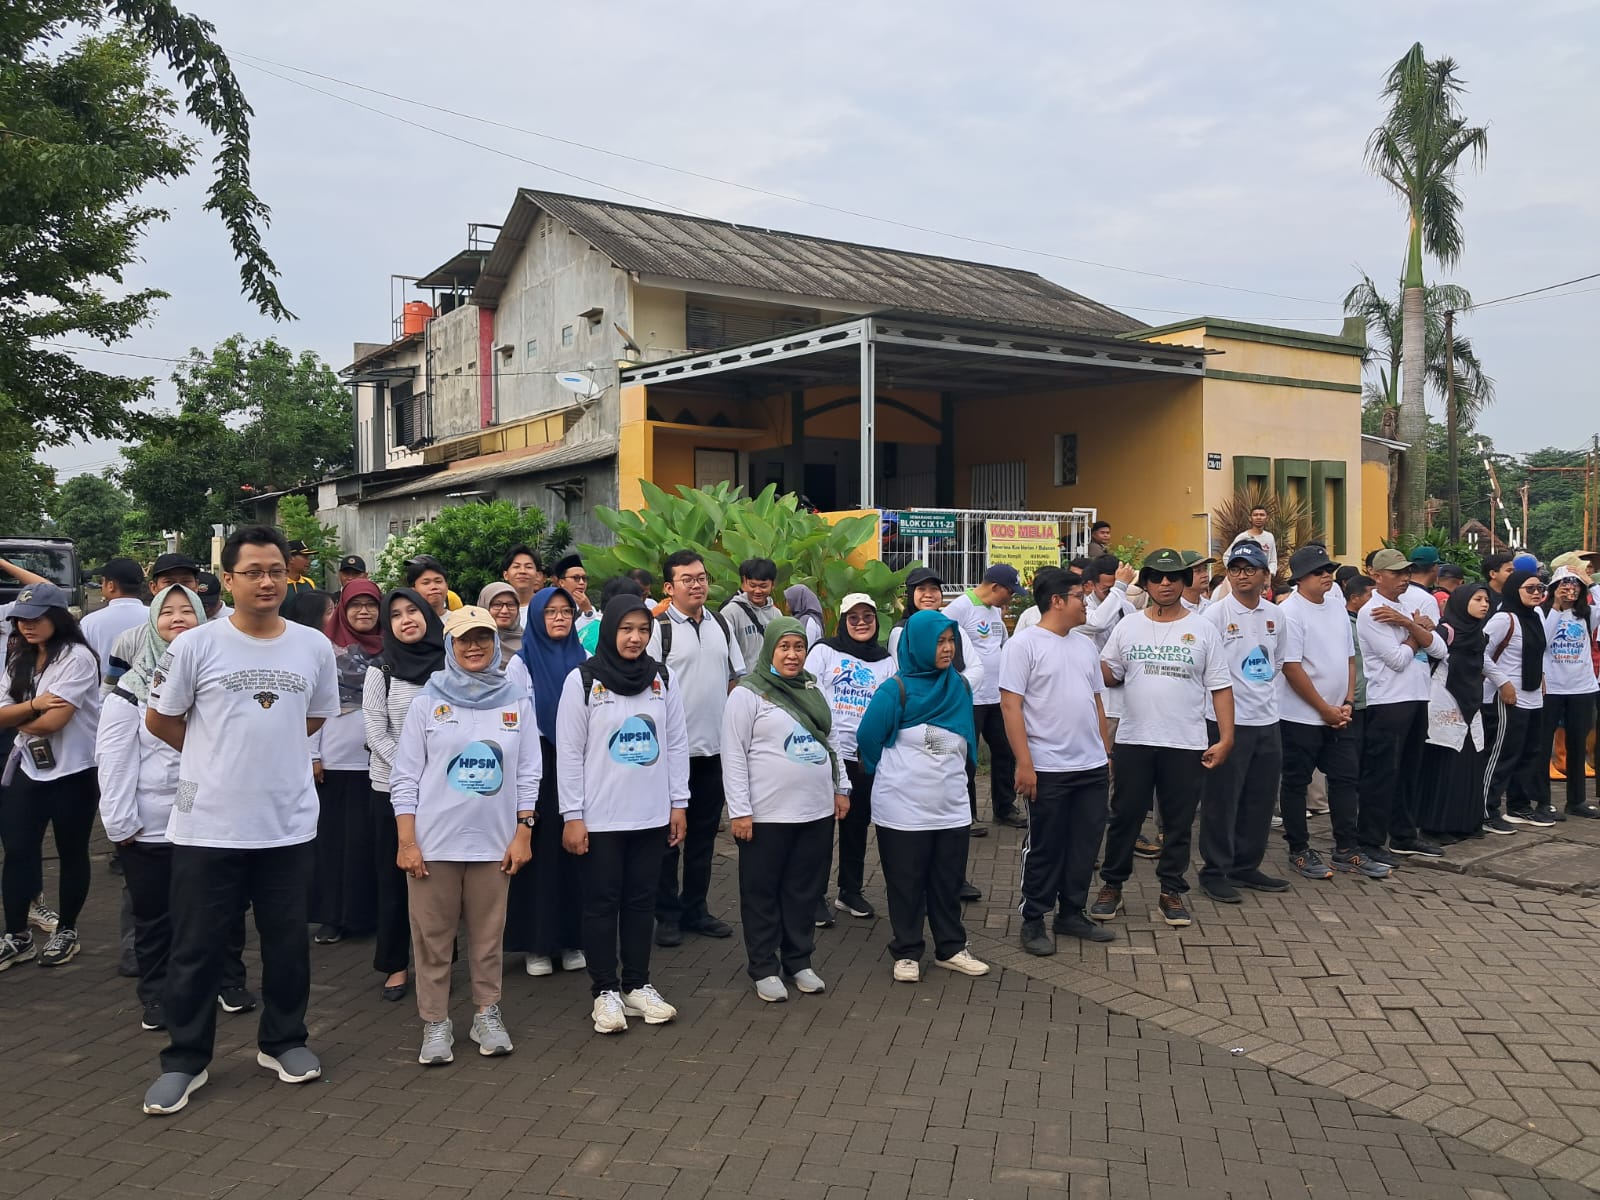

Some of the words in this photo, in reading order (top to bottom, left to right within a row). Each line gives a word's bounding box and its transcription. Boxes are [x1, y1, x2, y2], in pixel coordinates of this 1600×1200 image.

[900, 519, 920, 528] BLOK
[990, 523, 1016, 538] KOS
[1018, 524, 1056, 539] MELIA
[1550, 641, 1585, 649] Indonesia
[1125, 651, 1195, 666] INDONESIA
[834, 685, 872, 699] Indonesia
[619, 731, 651, 743] HPSN
[459, 758, 496, 769] HPSN
